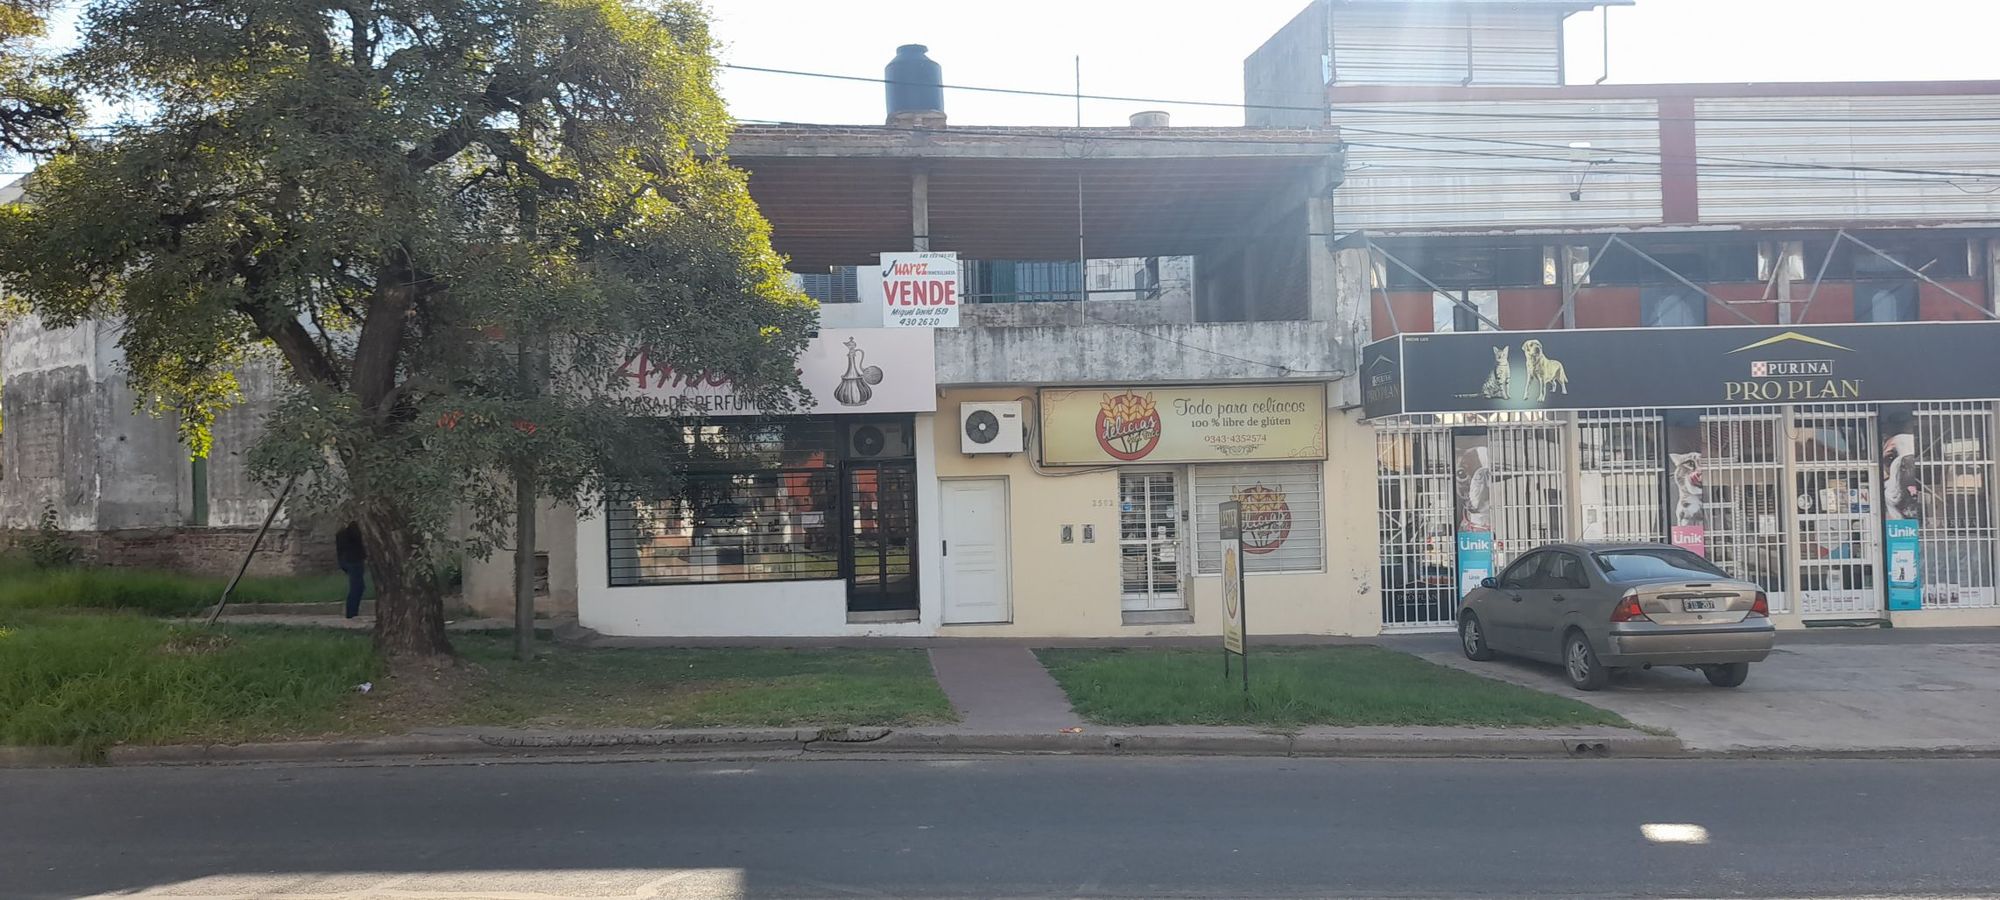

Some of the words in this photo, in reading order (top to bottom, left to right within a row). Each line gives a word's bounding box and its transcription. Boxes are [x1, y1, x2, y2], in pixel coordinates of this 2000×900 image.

[882, 259, 928, 277] Juarez
[883, 280, 956, 306] VENDE
[891, 308, 915, 317] Miguel
[915, 308, 935, 316] David
[1768, 362, 1829, 374] PURINA
[1725, 380, 1782, 400] PRO
[1787, 379, 1860, 399] PLAN
[669, 394, 687, 412] DE
[1173, 398, 1213, 416] Todo
[1217, 402, 1247, 418] para
[1253, 397, 1305, 413] celíacos
[1191, 419, 1208, 428] 100
[1211, 418, 1220, 427] %
[1222, 417, 1244, 427] libre
[1247, 417, 1259, 426] de
[1261, 416, 1291, 428] glúten
